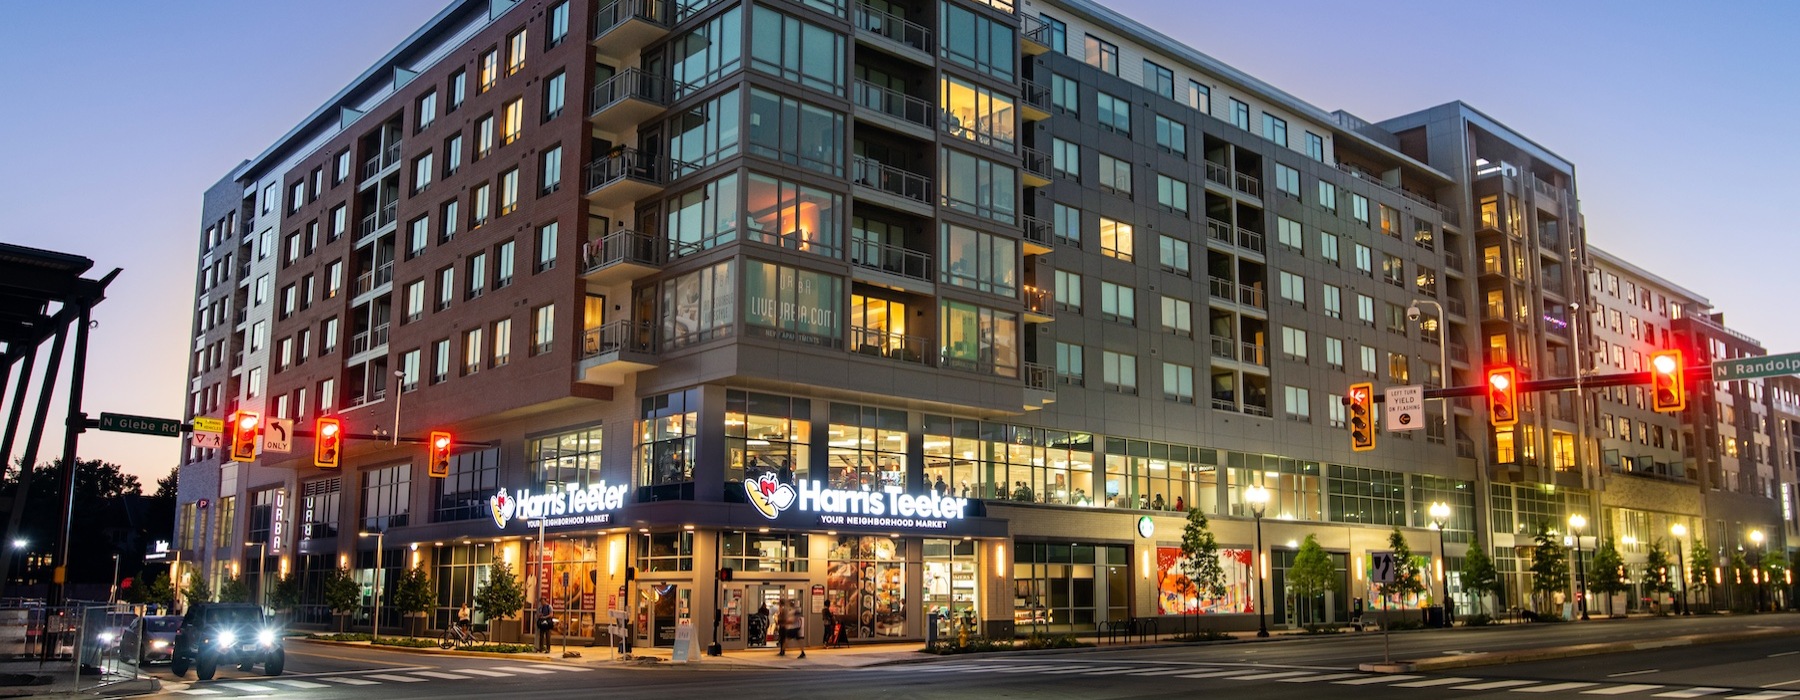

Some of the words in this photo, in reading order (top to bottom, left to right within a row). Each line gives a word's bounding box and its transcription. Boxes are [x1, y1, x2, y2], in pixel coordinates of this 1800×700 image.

[780, 273, 811, 295] URBA
[752, 296, 836, 328] LIVEURBA.COM
[782, 331, 820, 343] APATMENTS
[1717, 366, 1727, 376] N
[1736, 358, 1800, 375] Randolp
[104, 417, 112, 426] N
[119, 419, 155, 431] Glebe
[162, 422, 177, 433] Rd
[200, 500, 207, 508] P
[516, 485, 566, 518] Harris
[566, 480, 628, 513] Teeter
[799, 479, 885, 515] Harris
[885, 485, 967, 519] Teeter
[274, 495, 284, 549] URBA
[527, 519, 540, 528] YOUR
[585, 514, 609, 523] MARKET
[821, 515, 844, 524] YOUR
[847, 516, 913, 527] NEIGHBORHOOD
[916, 520, 947, 528] MARKET
